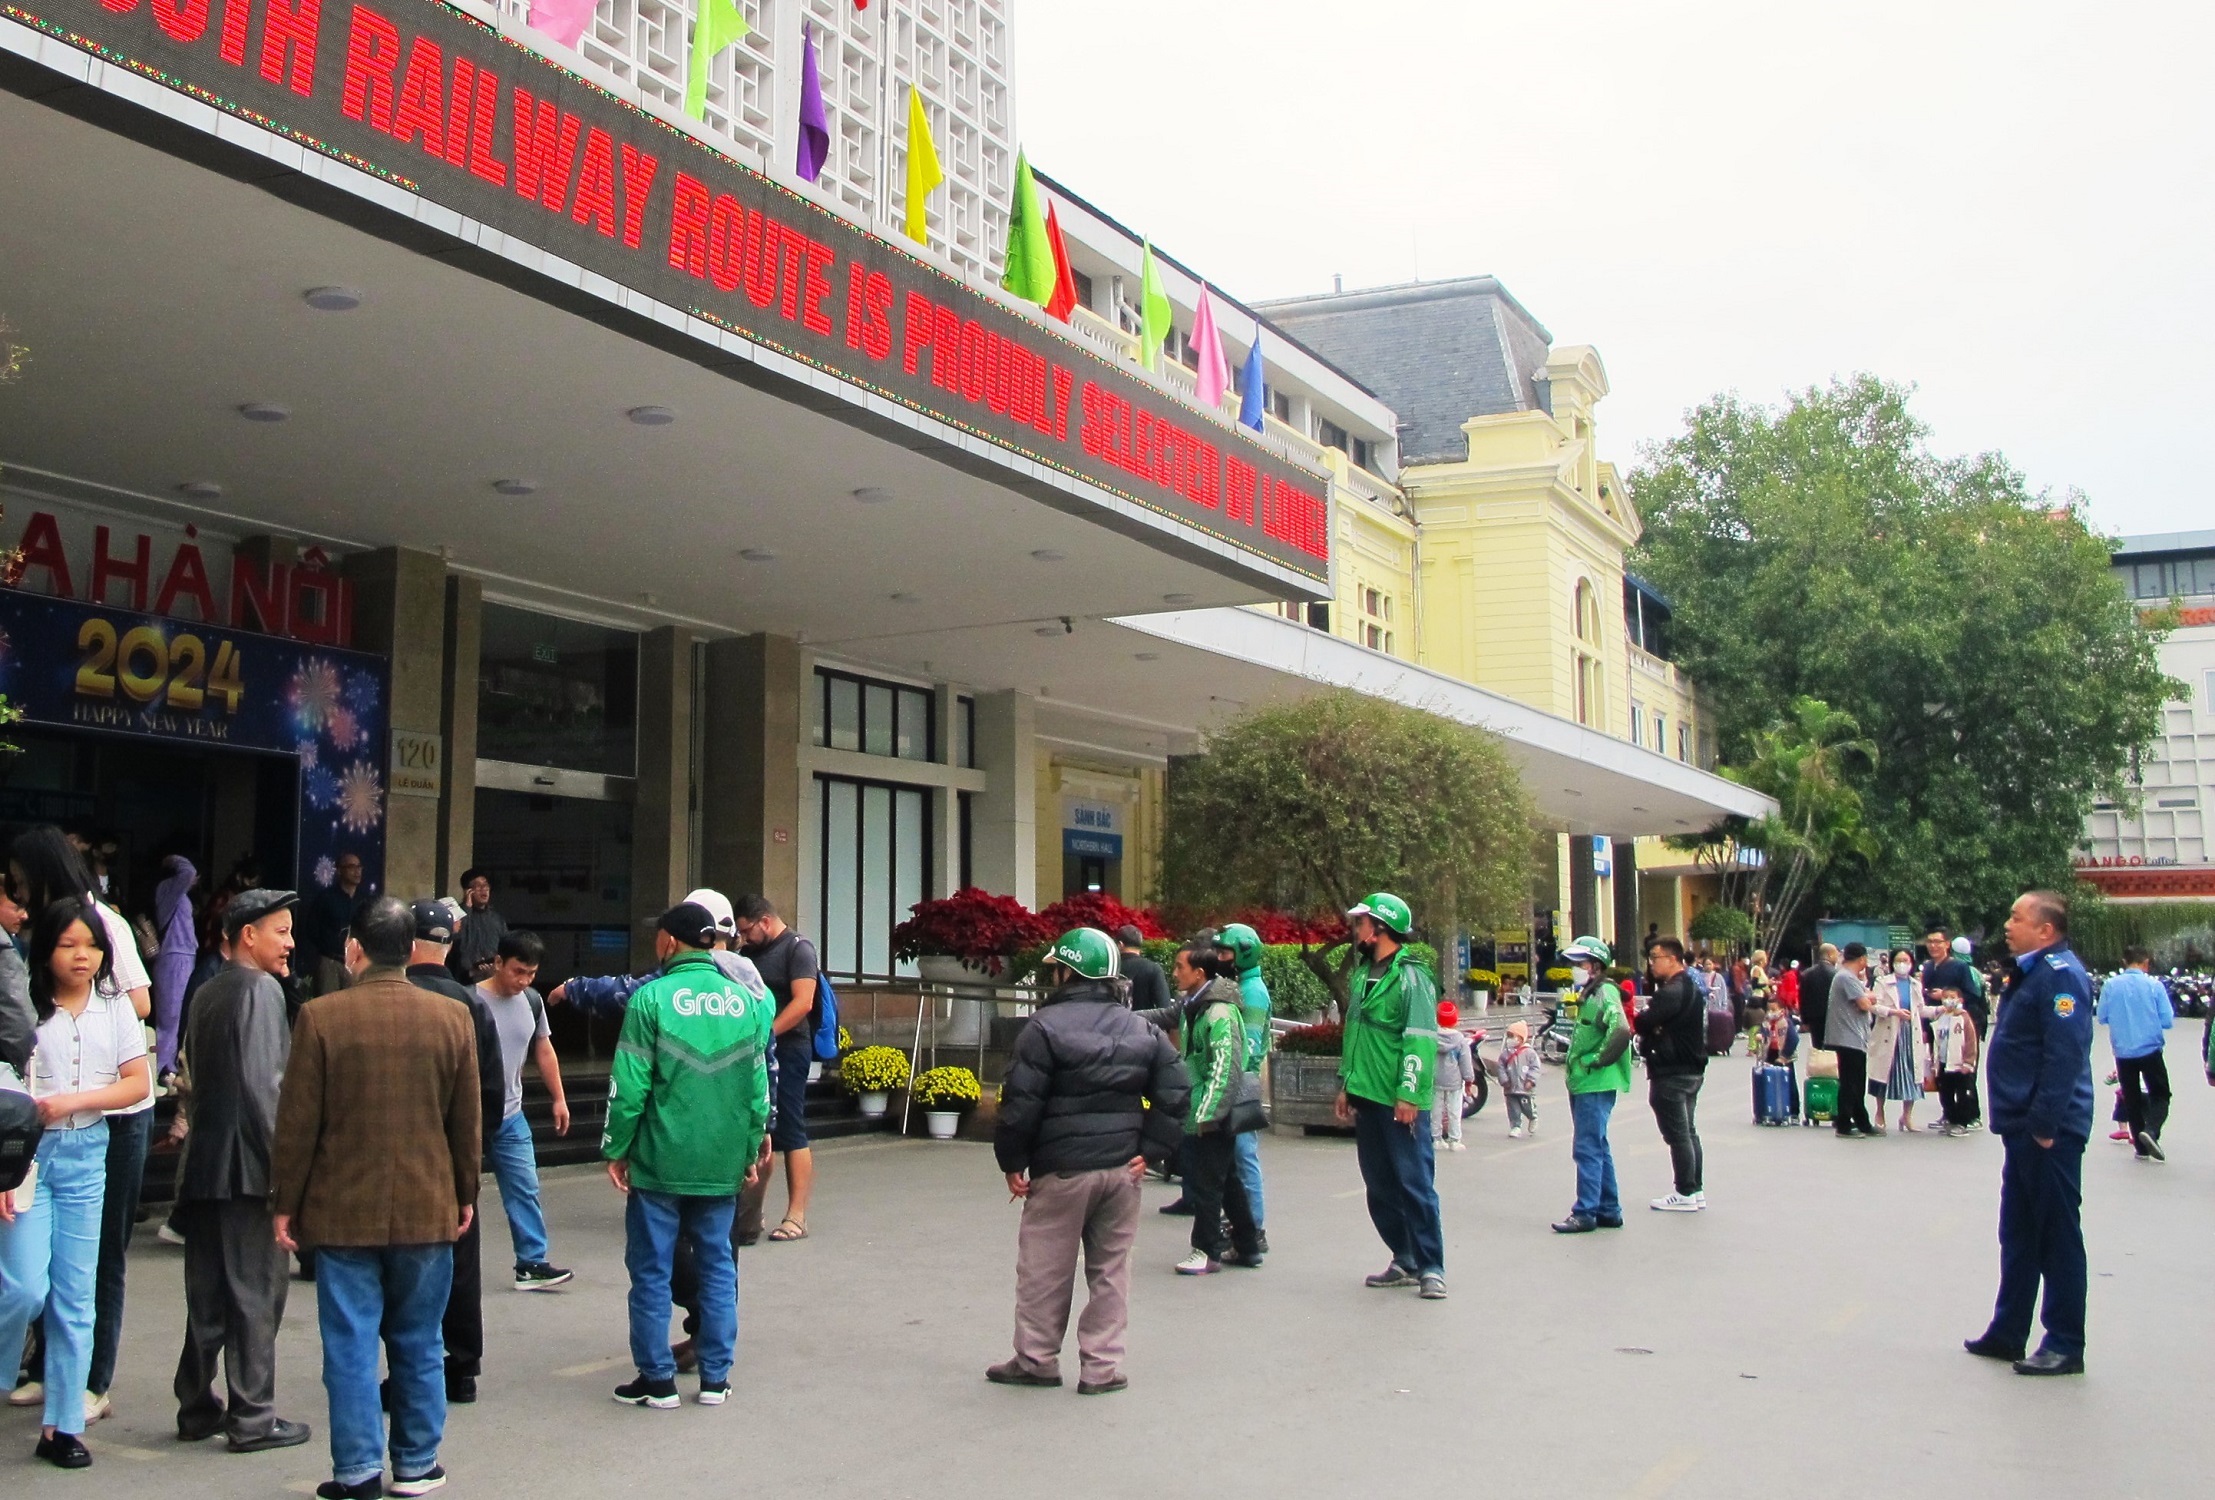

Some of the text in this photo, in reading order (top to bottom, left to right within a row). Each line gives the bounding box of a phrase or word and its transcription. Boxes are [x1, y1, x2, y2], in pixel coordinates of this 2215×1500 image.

[343, 6, 657, 249] RAILWAY
[668, 171, 835, 337] ROUTE
[847, 262, 895, 361] IS
[905, 291, 1075, 442] PROUDLY
[1080, 381, 1220, 511] SELECTED
[1226, 453, 1257, 527] BY
[75, 618, 244, 714] 2024
[535, 646, 557, 661] EXIT
[73, 702, 229, 739] HAPPY NEW YEAR
[398, 738, 434, 768] 120
[1377, 904, 1398, 920] Grab
[1059, 945, 1083, 963] Grab
[672, 985, 745, 1018] Grab
